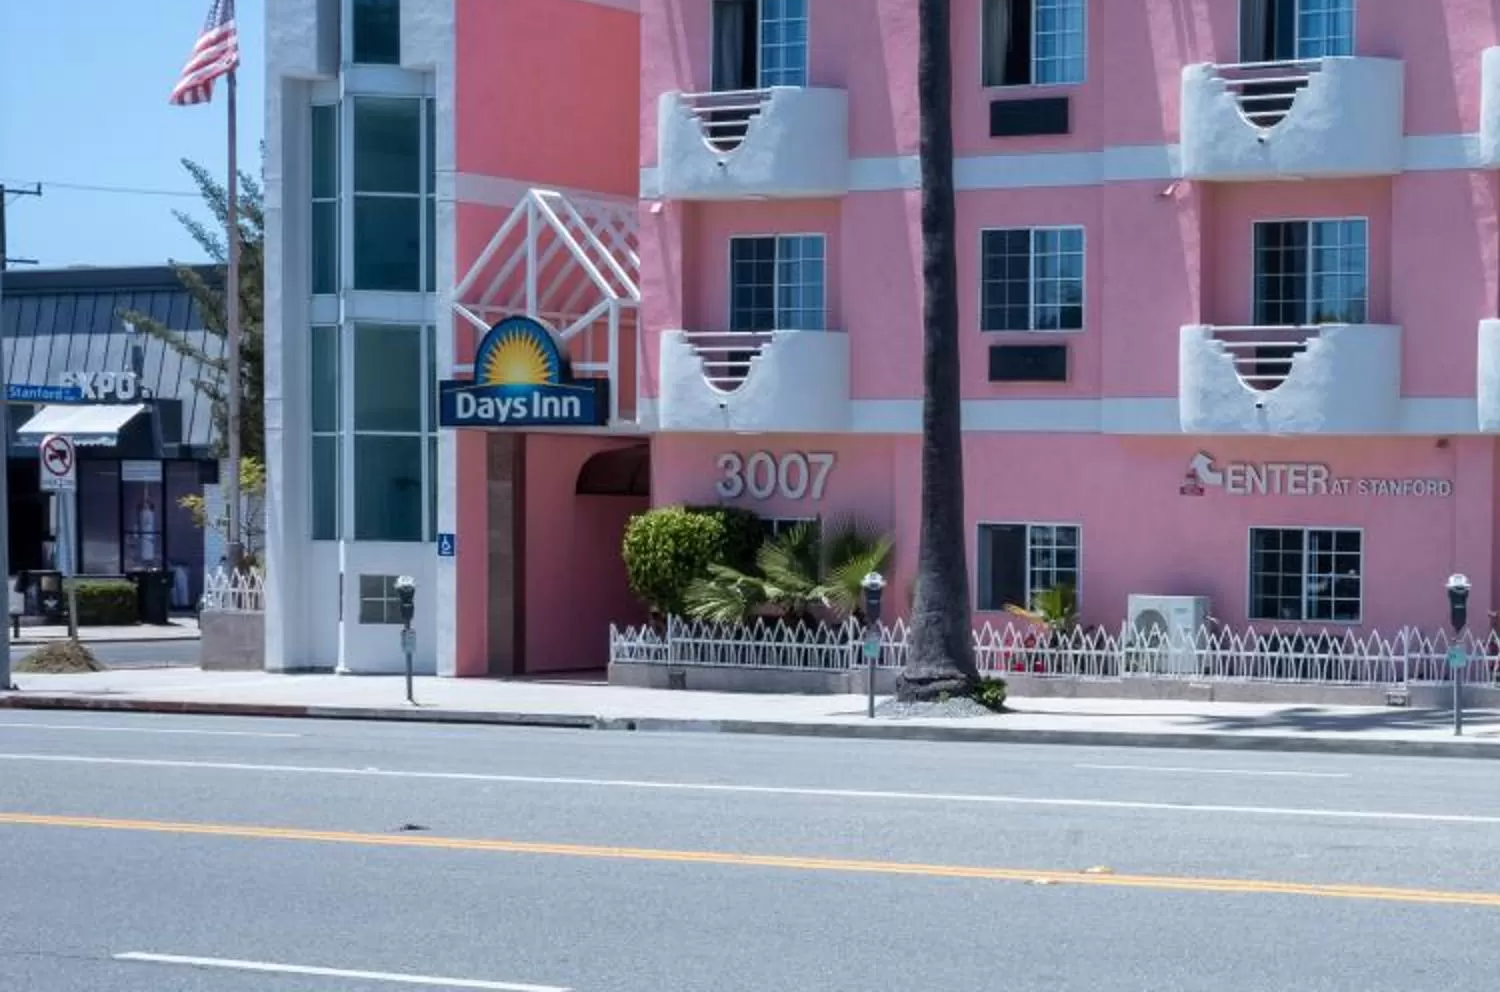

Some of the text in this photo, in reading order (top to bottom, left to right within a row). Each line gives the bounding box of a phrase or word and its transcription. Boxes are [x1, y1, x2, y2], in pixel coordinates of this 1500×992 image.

[9, 387, 63, 400] Stanford
[455, 391, 582, 423] Days Inn
[715, 451, 834, 500] 3007
[1226, 464, 1452, 497] ENTER AT STANFORD
